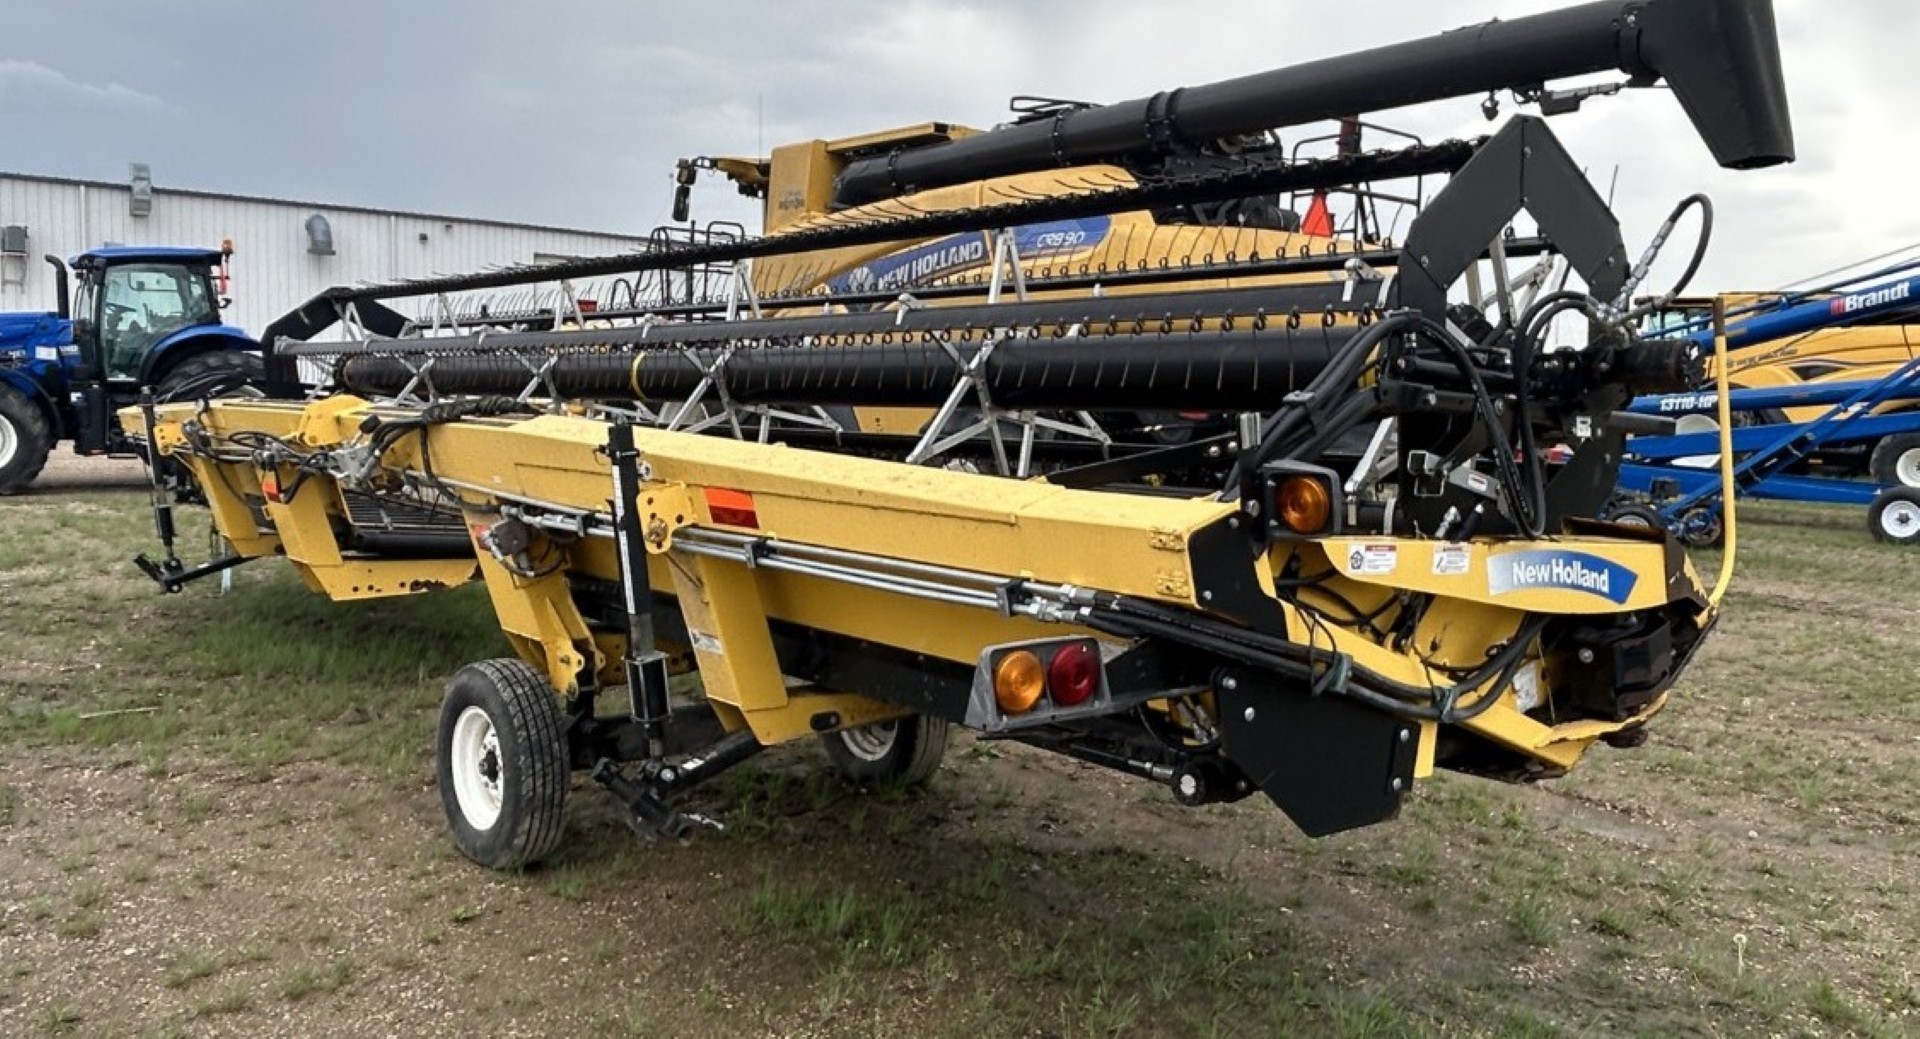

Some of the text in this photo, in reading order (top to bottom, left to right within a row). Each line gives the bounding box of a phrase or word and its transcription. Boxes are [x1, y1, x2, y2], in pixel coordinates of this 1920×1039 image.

[877, 241, 984, 290] NEW HOLLAND
[1845, 281, 1910, 313] Brandt
[1512, 558, 1610, 594] New Holland
